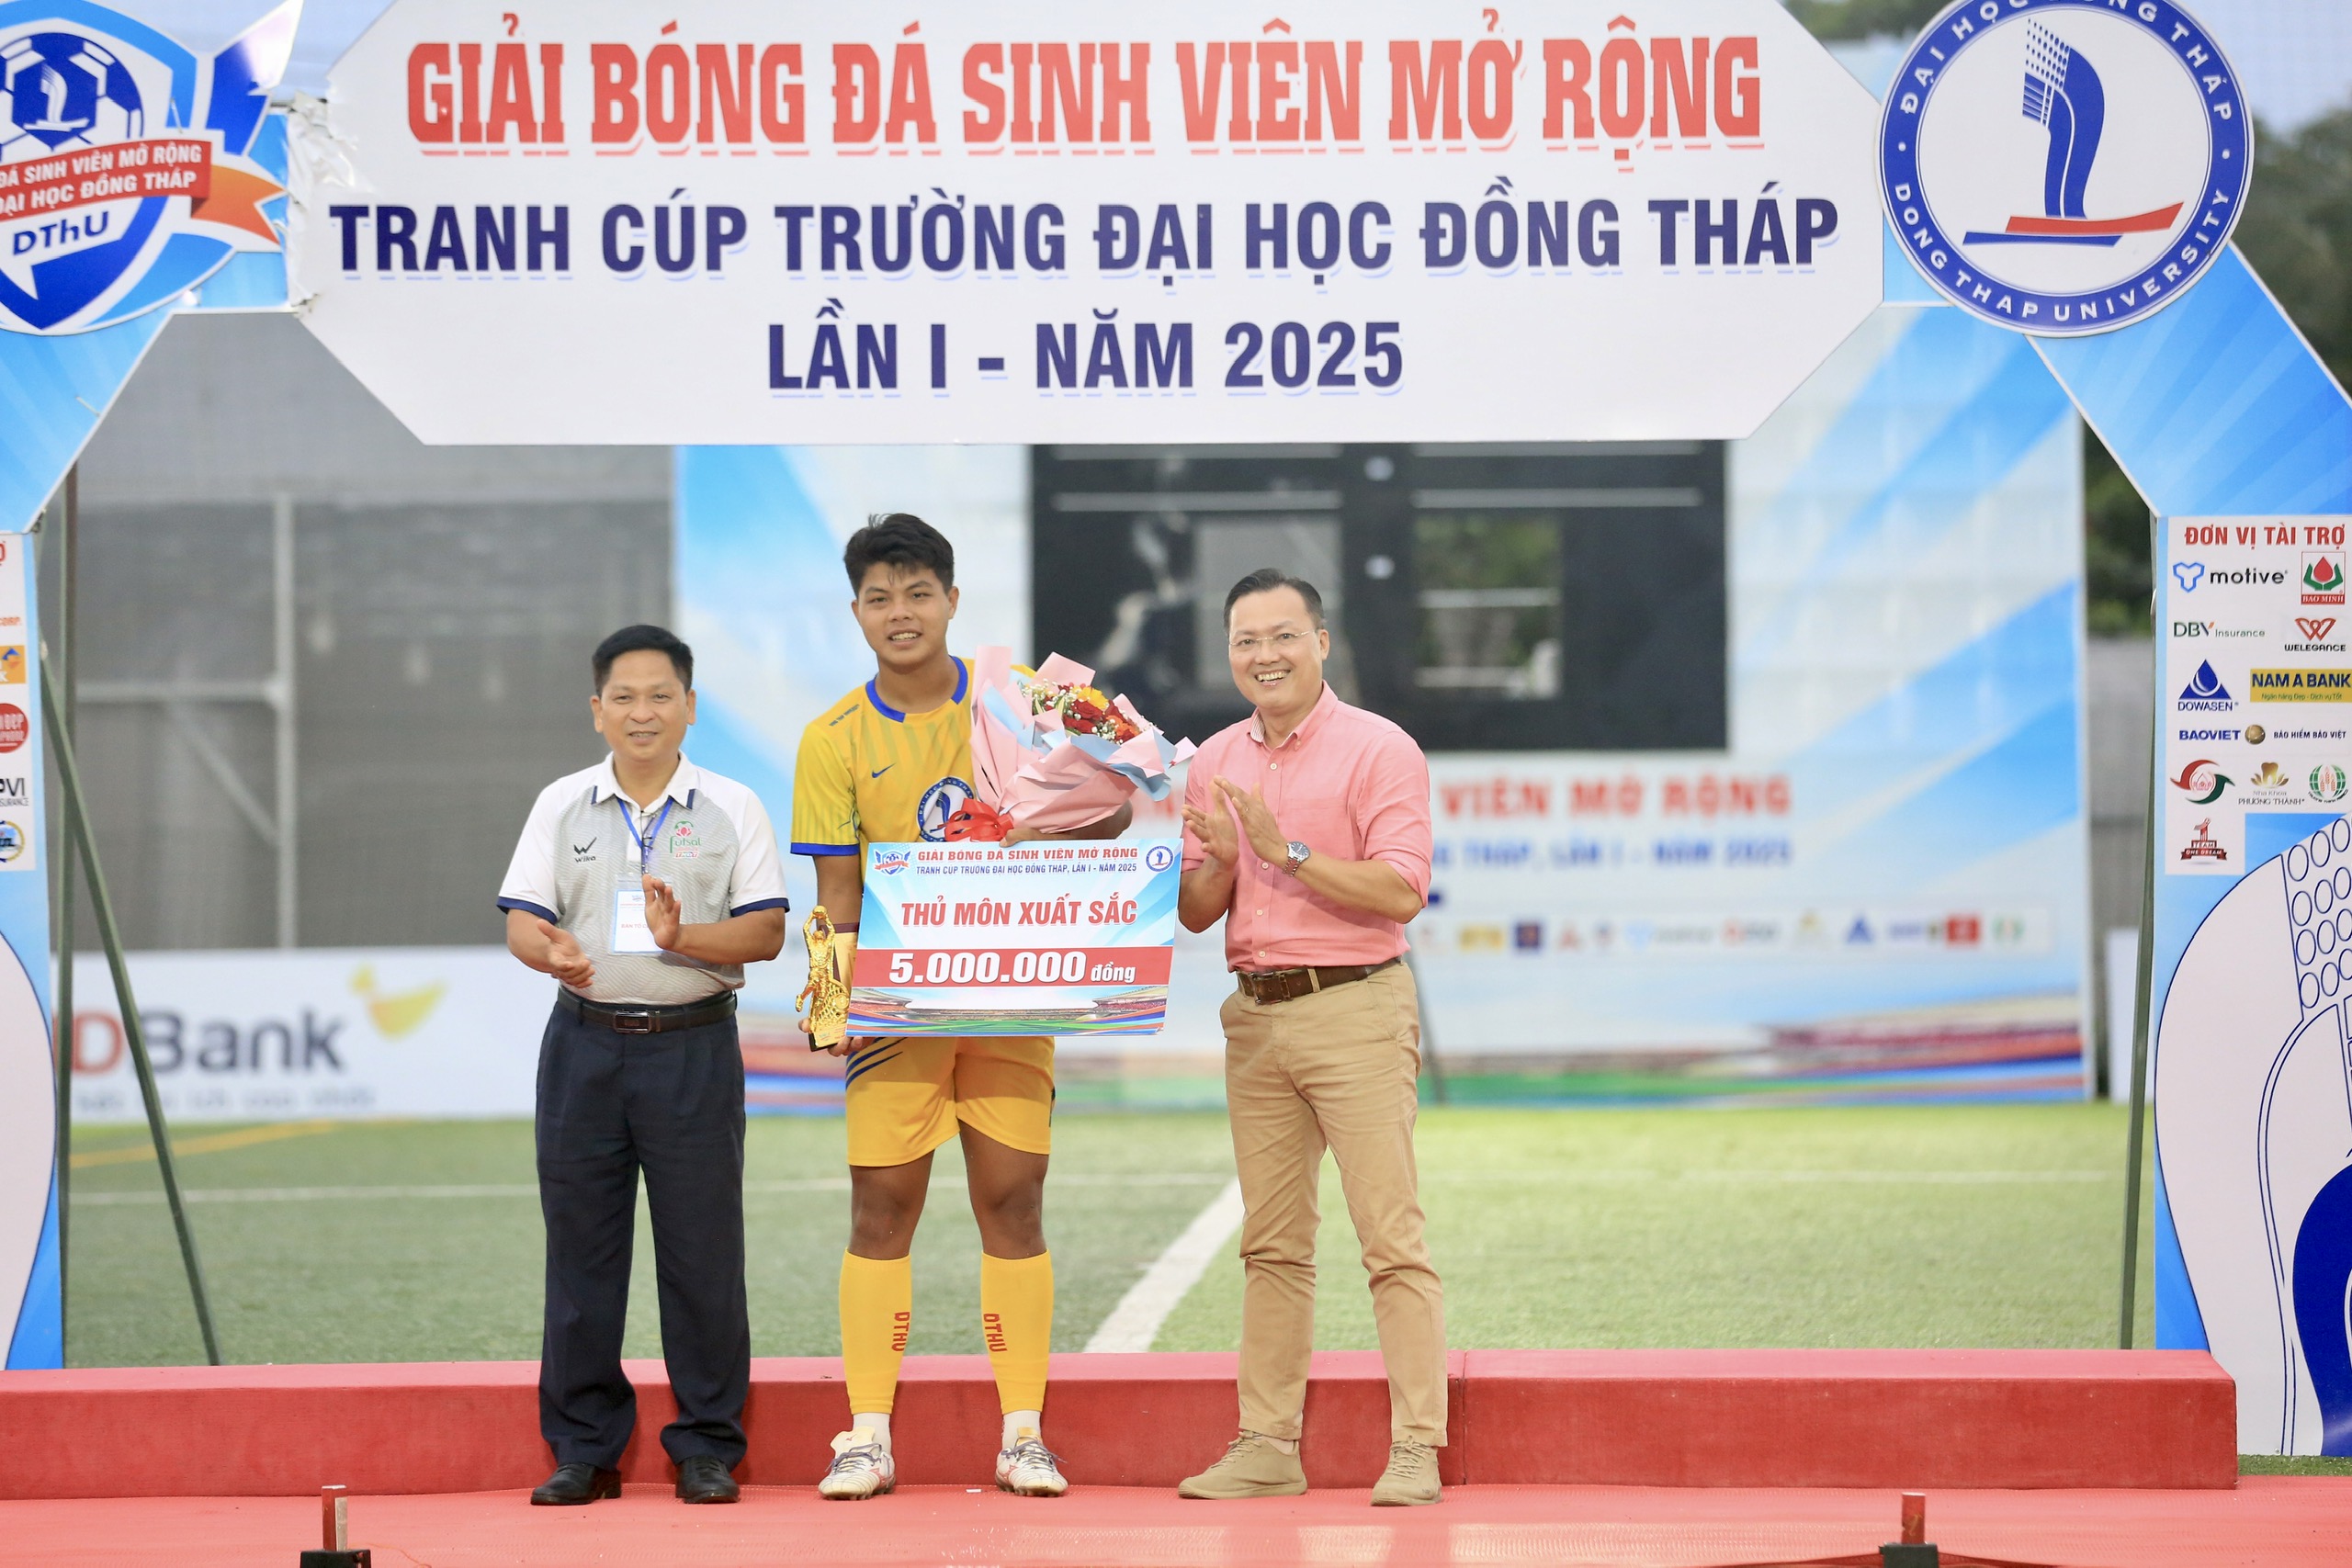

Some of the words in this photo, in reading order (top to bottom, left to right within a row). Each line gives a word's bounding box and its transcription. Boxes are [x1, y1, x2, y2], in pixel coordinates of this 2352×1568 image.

[408, 14, 565, 144] GIẢI
[591, 20, 806, 144] BÓNG
[831, 20, 938, 144] ĐÁ
[962, 41, 1151, 144] SINH
[1176, 17, 1363, 142] VIÊN
[1388, 8, 1523, 142] MỞ
[1543, 15, 1761, 161] RỘNG
[1900, 46, 1945, 115] ĐẠI
[2165, 21, 2233, 121] THÁP
[24, 159, 67, 184] SINH
[72, 149, 114, 175] VIÊN
[153, 143, 202, 167] RỘNG
[31, 186, 75, 209] HỌC
[80, 173, 138, 199] ĐỒNG
[143, 166, 198, 191] THÁP
[13, 210, 109, 256] DThU
[329, 204, 571, 272] TRANH
[601, 187, 748, 273] CÚP
[775, 187, 1067, 273] TRƯỜNG
[1092, 203, 1214, 286] ĐẠI
[1245, 200, 1393, 285] HỌC
[1419, 175, 1621, 269] ĐỒNG
[1648, 181, 1838, 267] THÁP
[1894, 182, 1949, 271] DONG
[1954, 269, 2040, 320] THAP
[2053, 187, 2230, 322] UNIVERSITY
[768, 298, 898, 389] LẦN
[930, 323, 946, 389] I
[1035, 308, 1193, 389] NĂM
[1223, 321, 1404, 389] 2025
[2184, 524, 2228, 546] ĐƠN
[2235, 525, 2256, 550] VỊ
[2263, 522, 2296, 546] TÀI
[2303, 524, 2346, 551] TRỢ
[2210, 568, 2285, 585] motive
[2215, 628, 2266, 638] Insurance
[2284, 644, 2346, 652] WELEGANCE
[2252, 672, 2290, 688] NAM
[2292, 672, 2304, 688] A
[2307, 672, 2352, 688] BANK
[2177, 701, 2233, 712] DOWASEN
[2179, 729, 2241, 740] BAOVIET
[2330, 729, 2346, 740] VIỆT
[1438, 775, 1554, 819] VIÊN
[917, 865, 941, 874] TRANH
[992, 865, 1006, 875] ĐẠI
[1007, 865, 1023, 875] HỌC
[1099, 863, 1116, 872] NĂM
[1118, 863, 1137, 872] 2025
[918, 849, 944, 861] GIẢI
[948, 850, 982, 861] BÓNG
[987, 849, 1003, 861] ĐÁ
[1008, 850, 1039, 861] SINH
[1044, 848, 1074, 860] VIÊN
[1078, 846, 1100, 859] MỞ
[1102, 847, 1138, 861] RỘNG
[901, 895, 946, 926] THỦ
[953, 897, 1012, 926] MÔN
[1018, 893, 1082, 925] XUẤT
[1088, 891, 1138, 925] SẮC
[889, 950, 1087, 985] 5.000.000
[1091, 961, 1136, 985] đồng
[52, 1006, 345, 1076] DBank
